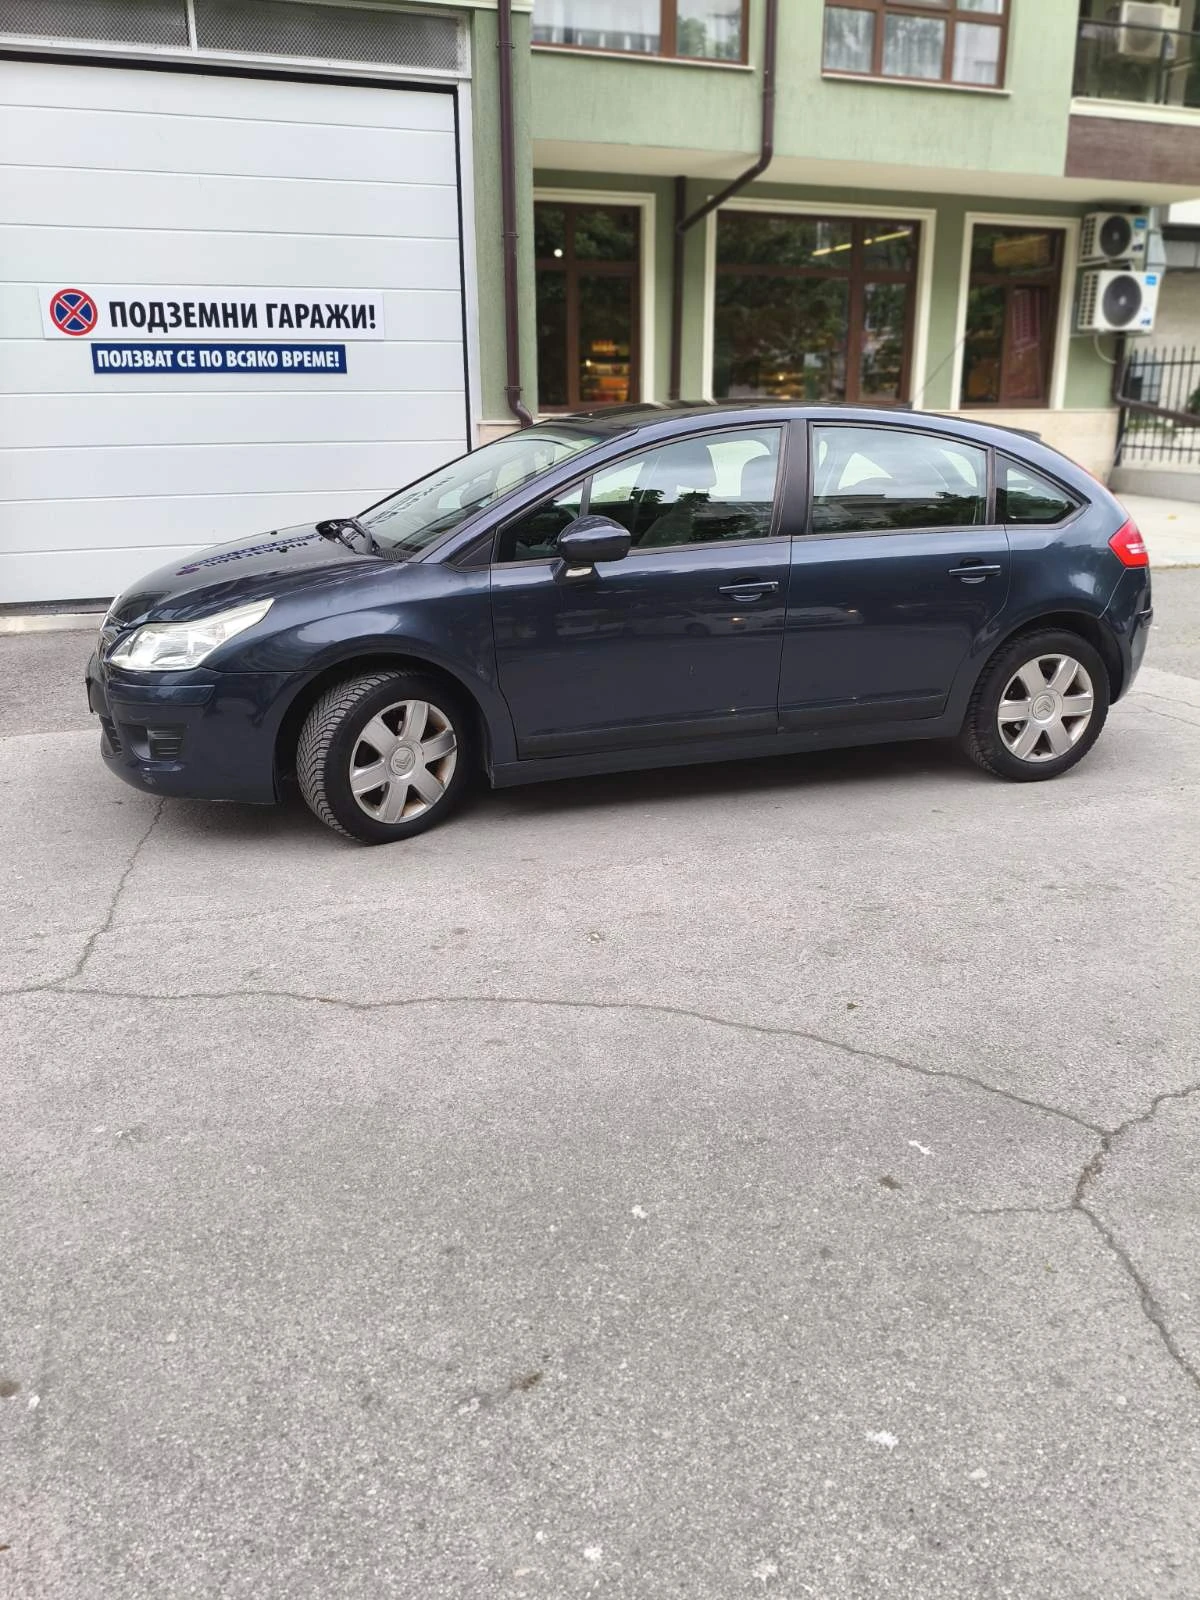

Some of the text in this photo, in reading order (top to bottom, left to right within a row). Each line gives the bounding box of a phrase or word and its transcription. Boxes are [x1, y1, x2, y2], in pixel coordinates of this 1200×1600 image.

[109, 301, 376, 333] ПОДЗЕМНИ ГАРАЖИ!
[97, 350, 340, 368] ПОЛЗВАТ СЕ ПО ВСЯКО ВРЕМЕ!
